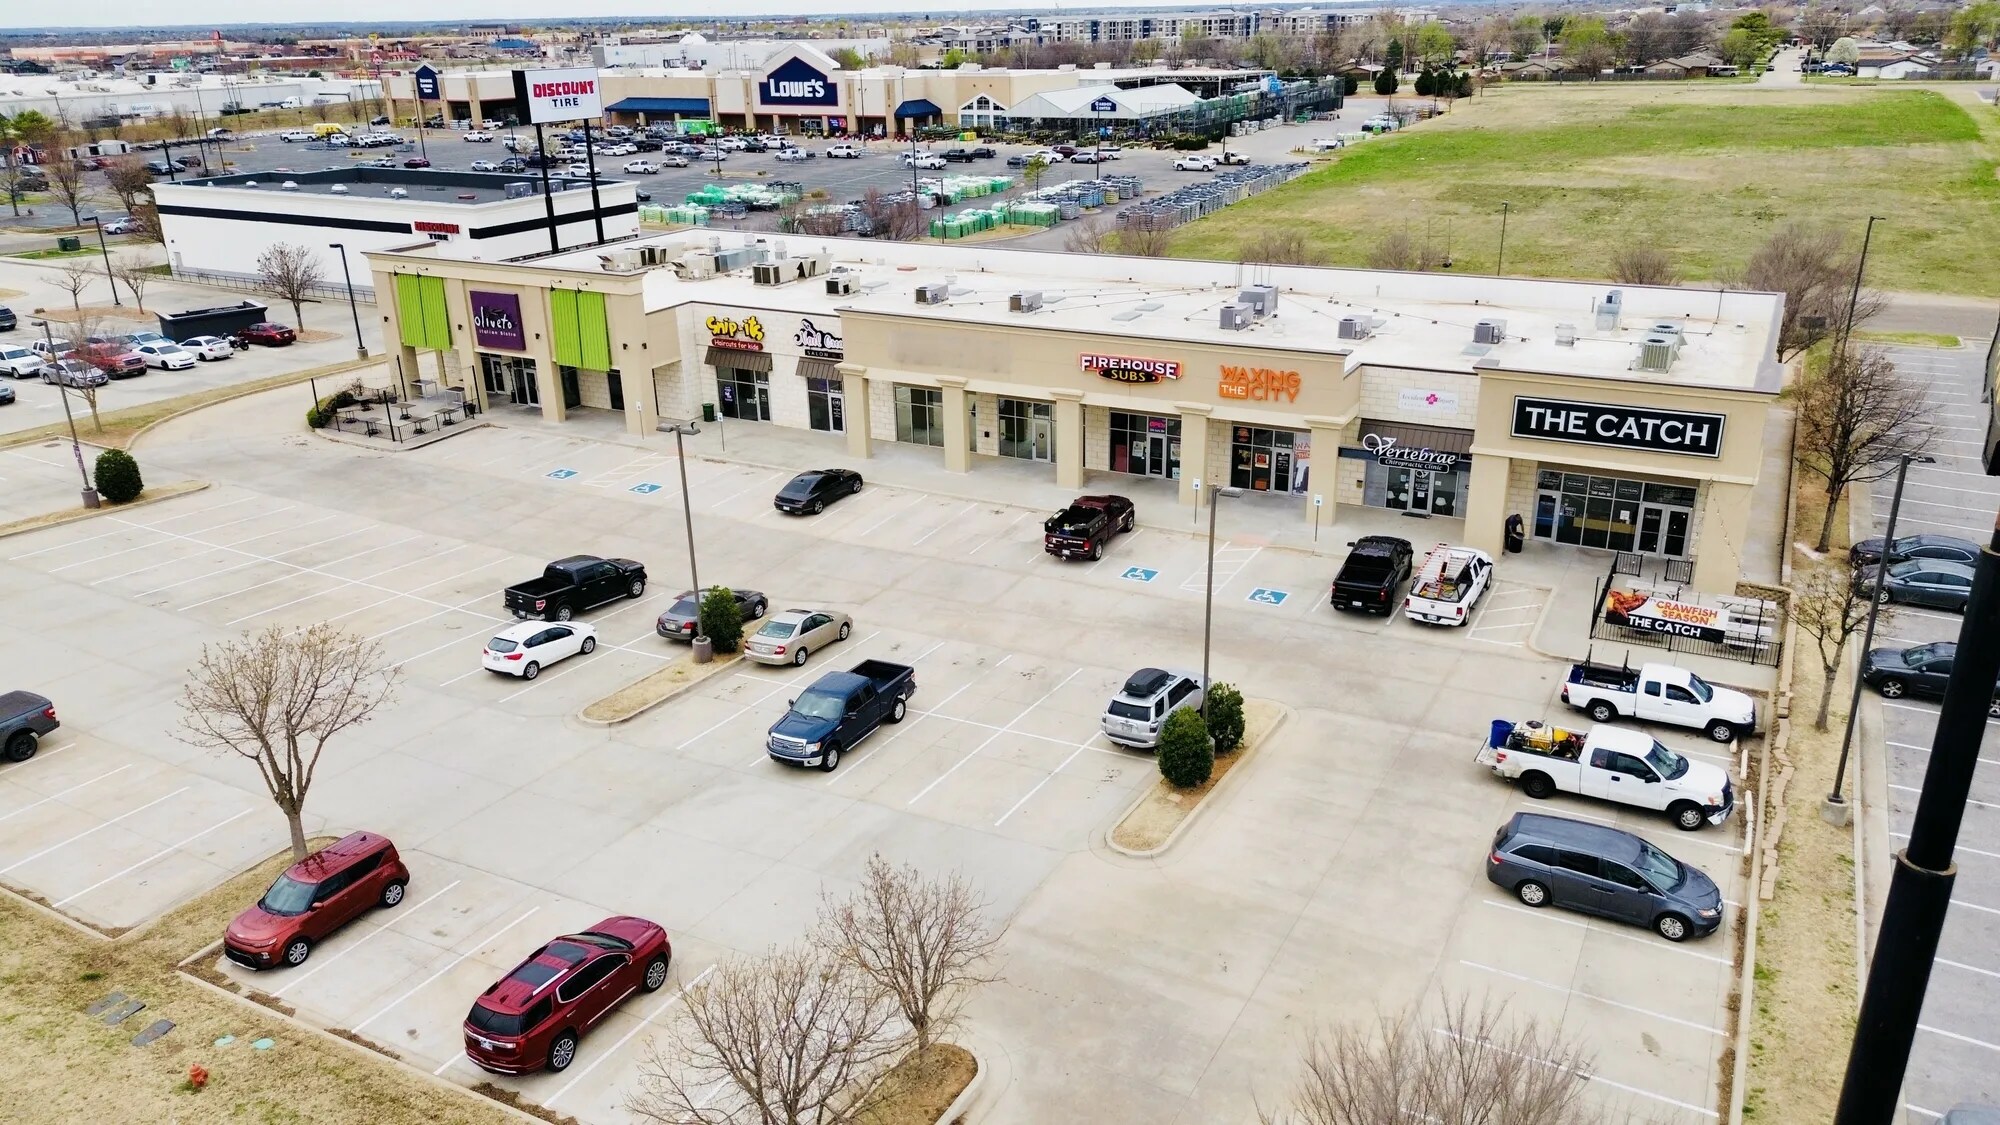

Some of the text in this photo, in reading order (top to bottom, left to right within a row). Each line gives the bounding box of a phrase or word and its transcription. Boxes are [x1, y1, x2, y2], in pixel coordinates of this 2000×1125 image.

[532, 80, 595, 98] DISCOUNT
[769, 78, 825, 98] LOWE'S
[551, 97, 579, 107] TIRE
[414, 221, 460, 234] DISCOUNT
[428, 233, 449, 241] TIRE
[474, 305, 513, 330] oliveto
[1081, 356, 1177, 380] FIREHOUSE
[1111, 369, 1146, 382] SUBS
[1220, 365, 1302, 388] WAXING
[1221, 384, 1299, 403] THE CITY
[1525, 406, 1710, 447] THE CATCH
[1362, 433, 1456, 465] Vertebrae
[1385, 458, 1443, 471] Chiropractic Clinic
[1656, 600, 1718, 618] CRAWFISH
[1661, 610, 1709, 625] SEASON
[1628, 615, 1701, 638] THE CATCH
